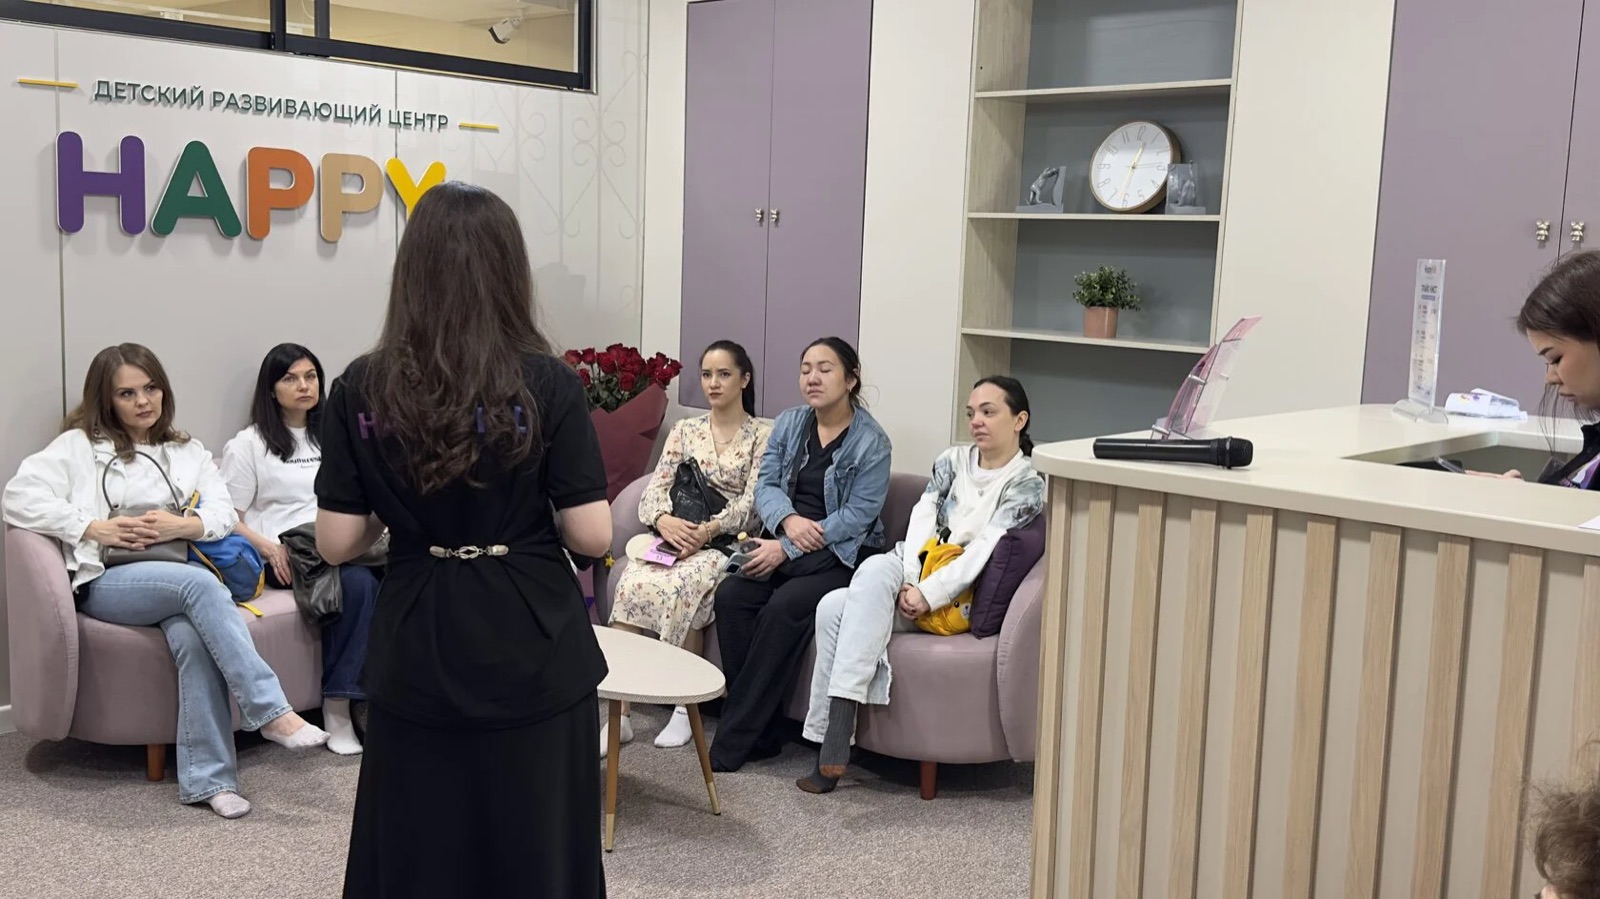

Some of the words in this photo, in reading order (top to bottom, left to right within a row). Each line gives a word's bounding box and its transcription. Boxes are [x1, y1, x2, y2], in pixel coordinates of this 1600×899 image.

[94, 80, 204, 106] ДЕТСКИЙ
[212, 91, 382, 124] РАЗВИВАЮЩИЙ
[388, 109, 449, 129] ЦЕНТР
[56, 131, 447, 243] HAPPY
